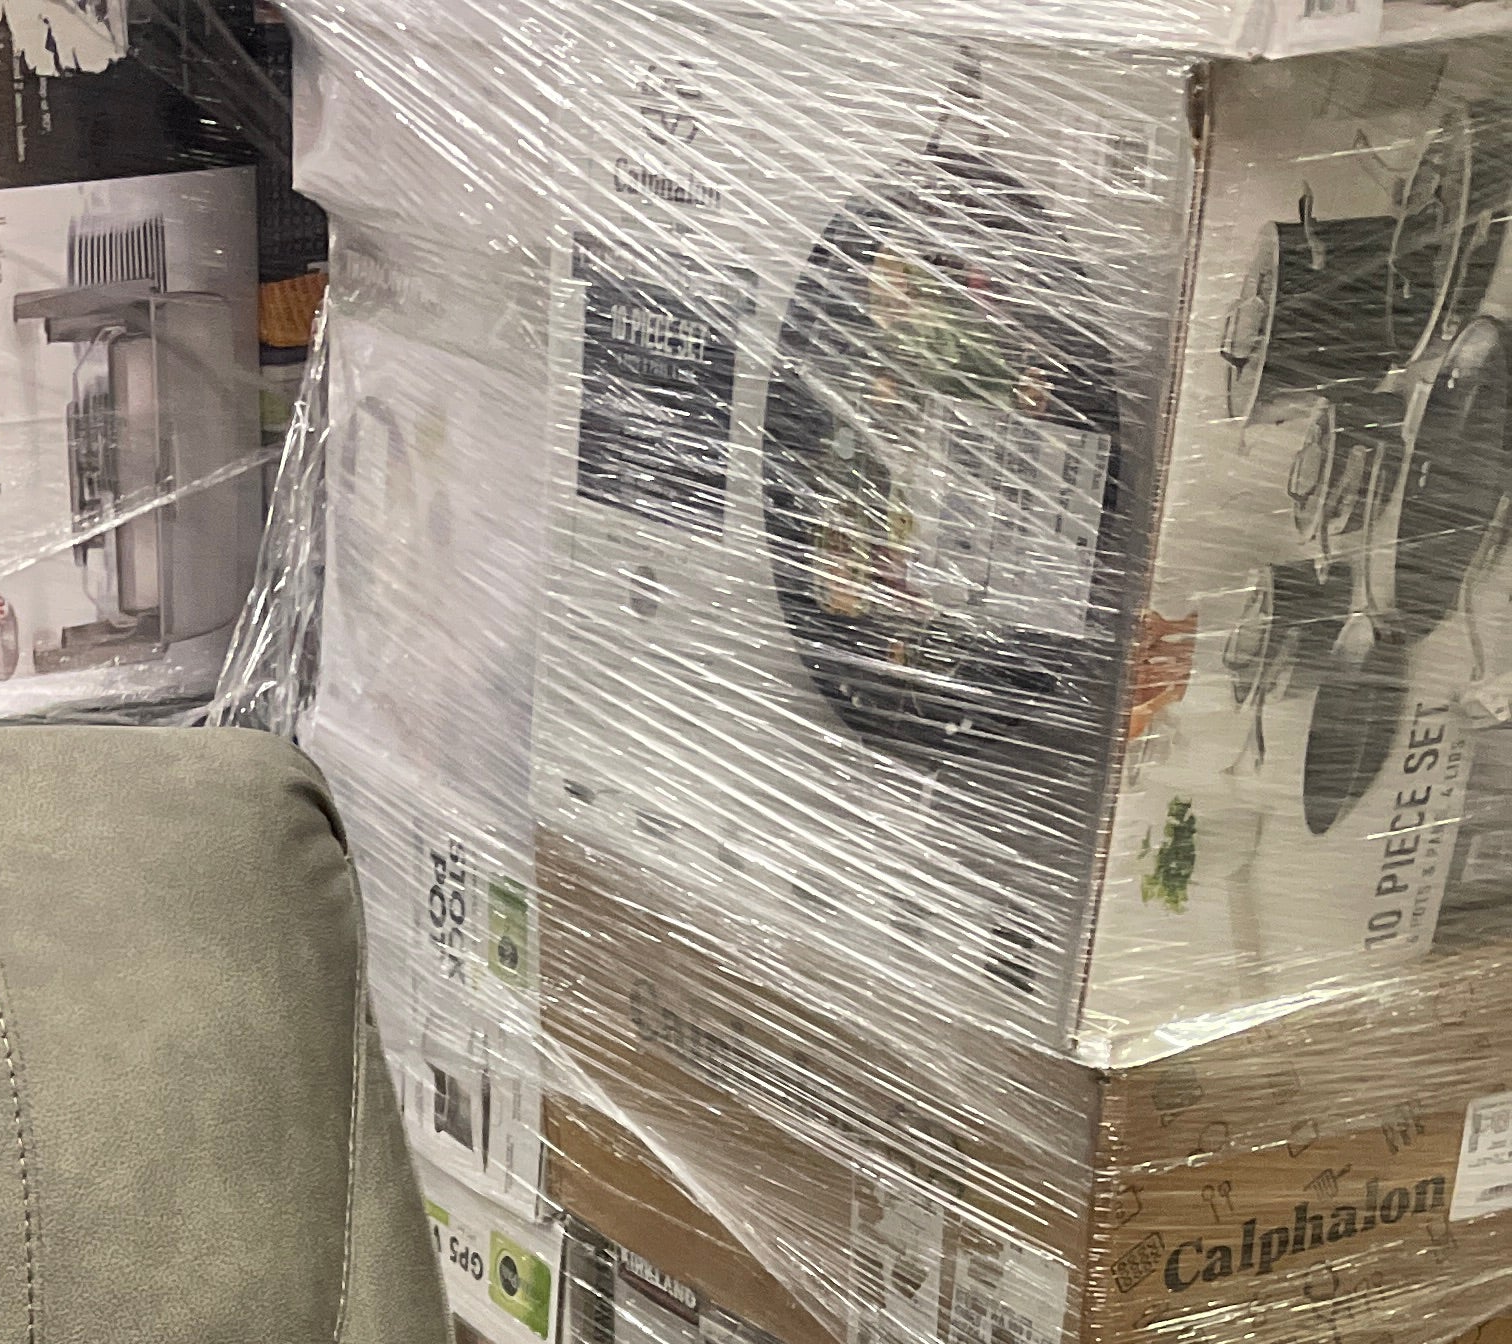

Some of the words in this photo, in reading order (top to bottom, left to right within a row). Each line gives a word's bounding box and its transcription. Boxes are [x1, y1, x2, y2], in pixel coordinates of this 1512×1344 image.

[1404, 702, 1450, 774] SET
[1375, 785, 1433, 897] PIECE
[1364, 908, 1403, 950] 10
[1163, 1174, 1447, 1293] Calphalon
